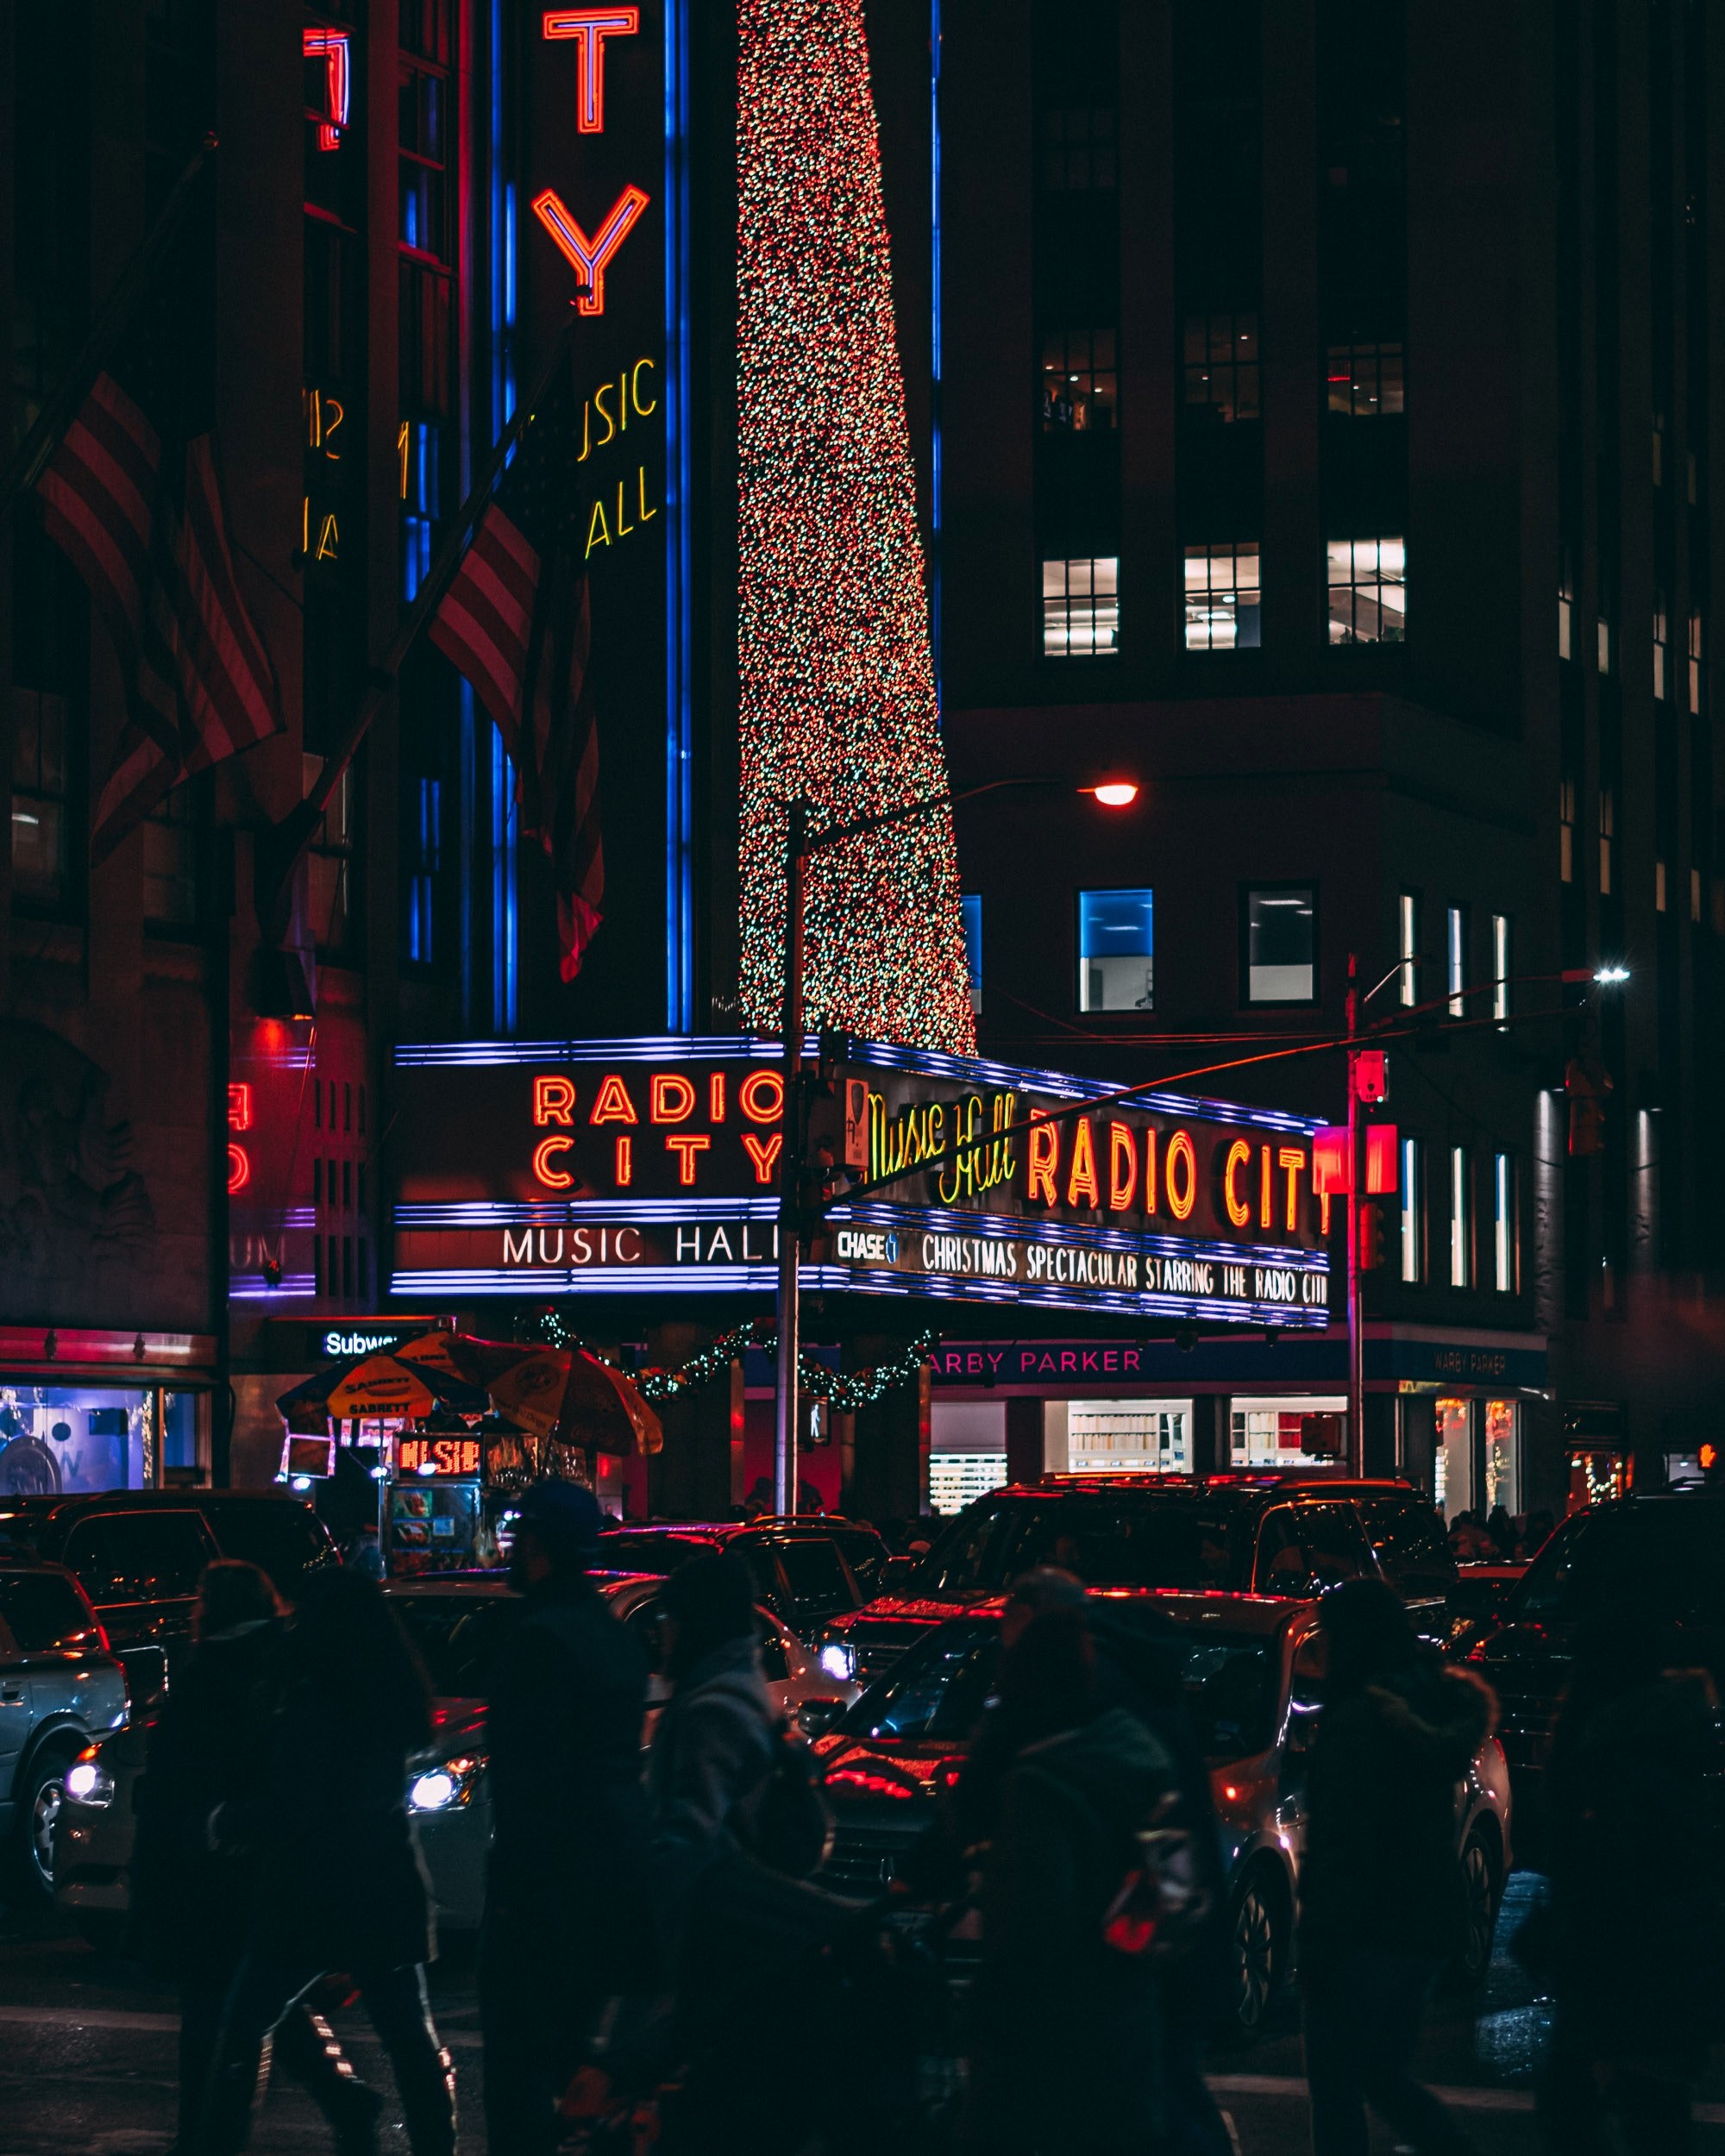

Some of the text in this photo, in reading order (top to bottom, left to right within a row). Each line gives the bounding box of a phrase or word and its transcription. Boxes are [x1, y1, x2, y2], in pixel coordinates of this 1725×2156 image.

[575, 357, 657, 462] SIC
[585, 465, 657, 561] ALL
[533, 1069, 784, 1125] RADIO
[531, 1132, 783, 1190] CITY
[1027, 1107, 1198, 1221] RADIO
[503, 1226, 641, 1264] MUSIC
[837, 1232, 886, 1261] CHASE
[922, 1234, 1018, 1277] CHRISTMAS
[1026, 1244, 1138, 1288] SPECTACULAR
[1145, 1257, 1214, 1294] STARRING
[1222, 1264, 1247, 1298] THE
[1255, 1269, 1296, 1302] RADIO
[326, 1332, 398, 1355] Subw
[929, 1351, 1141, 1374] ARBY PARKER
[349, 1402, 411, 1415] SABRETT
